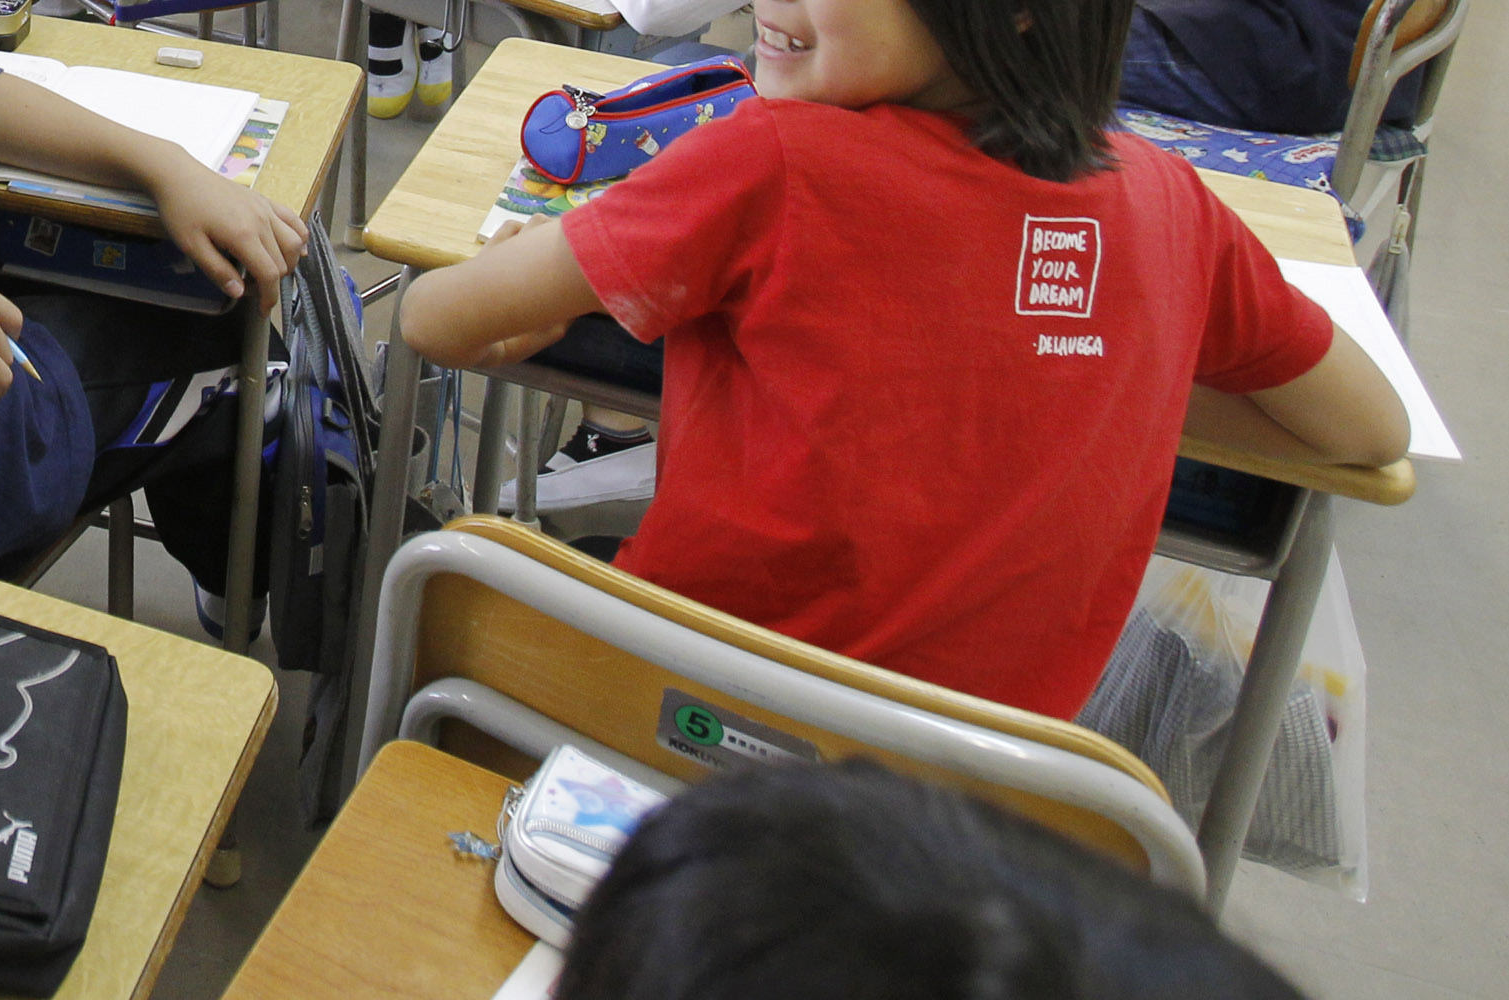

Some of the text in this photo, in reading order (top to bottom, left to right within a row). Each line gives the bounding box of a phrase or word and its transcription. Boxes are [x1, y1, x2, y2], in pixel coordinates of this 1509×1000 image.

[1032, 227, 1087, 255] BECOME
[1032, 258, 1080, 281] YOUR
[1029, 283, 1084, 309] DREAM
[686, 711, 711, 739] 5
[667, 737, 729, 770] KOKUY
